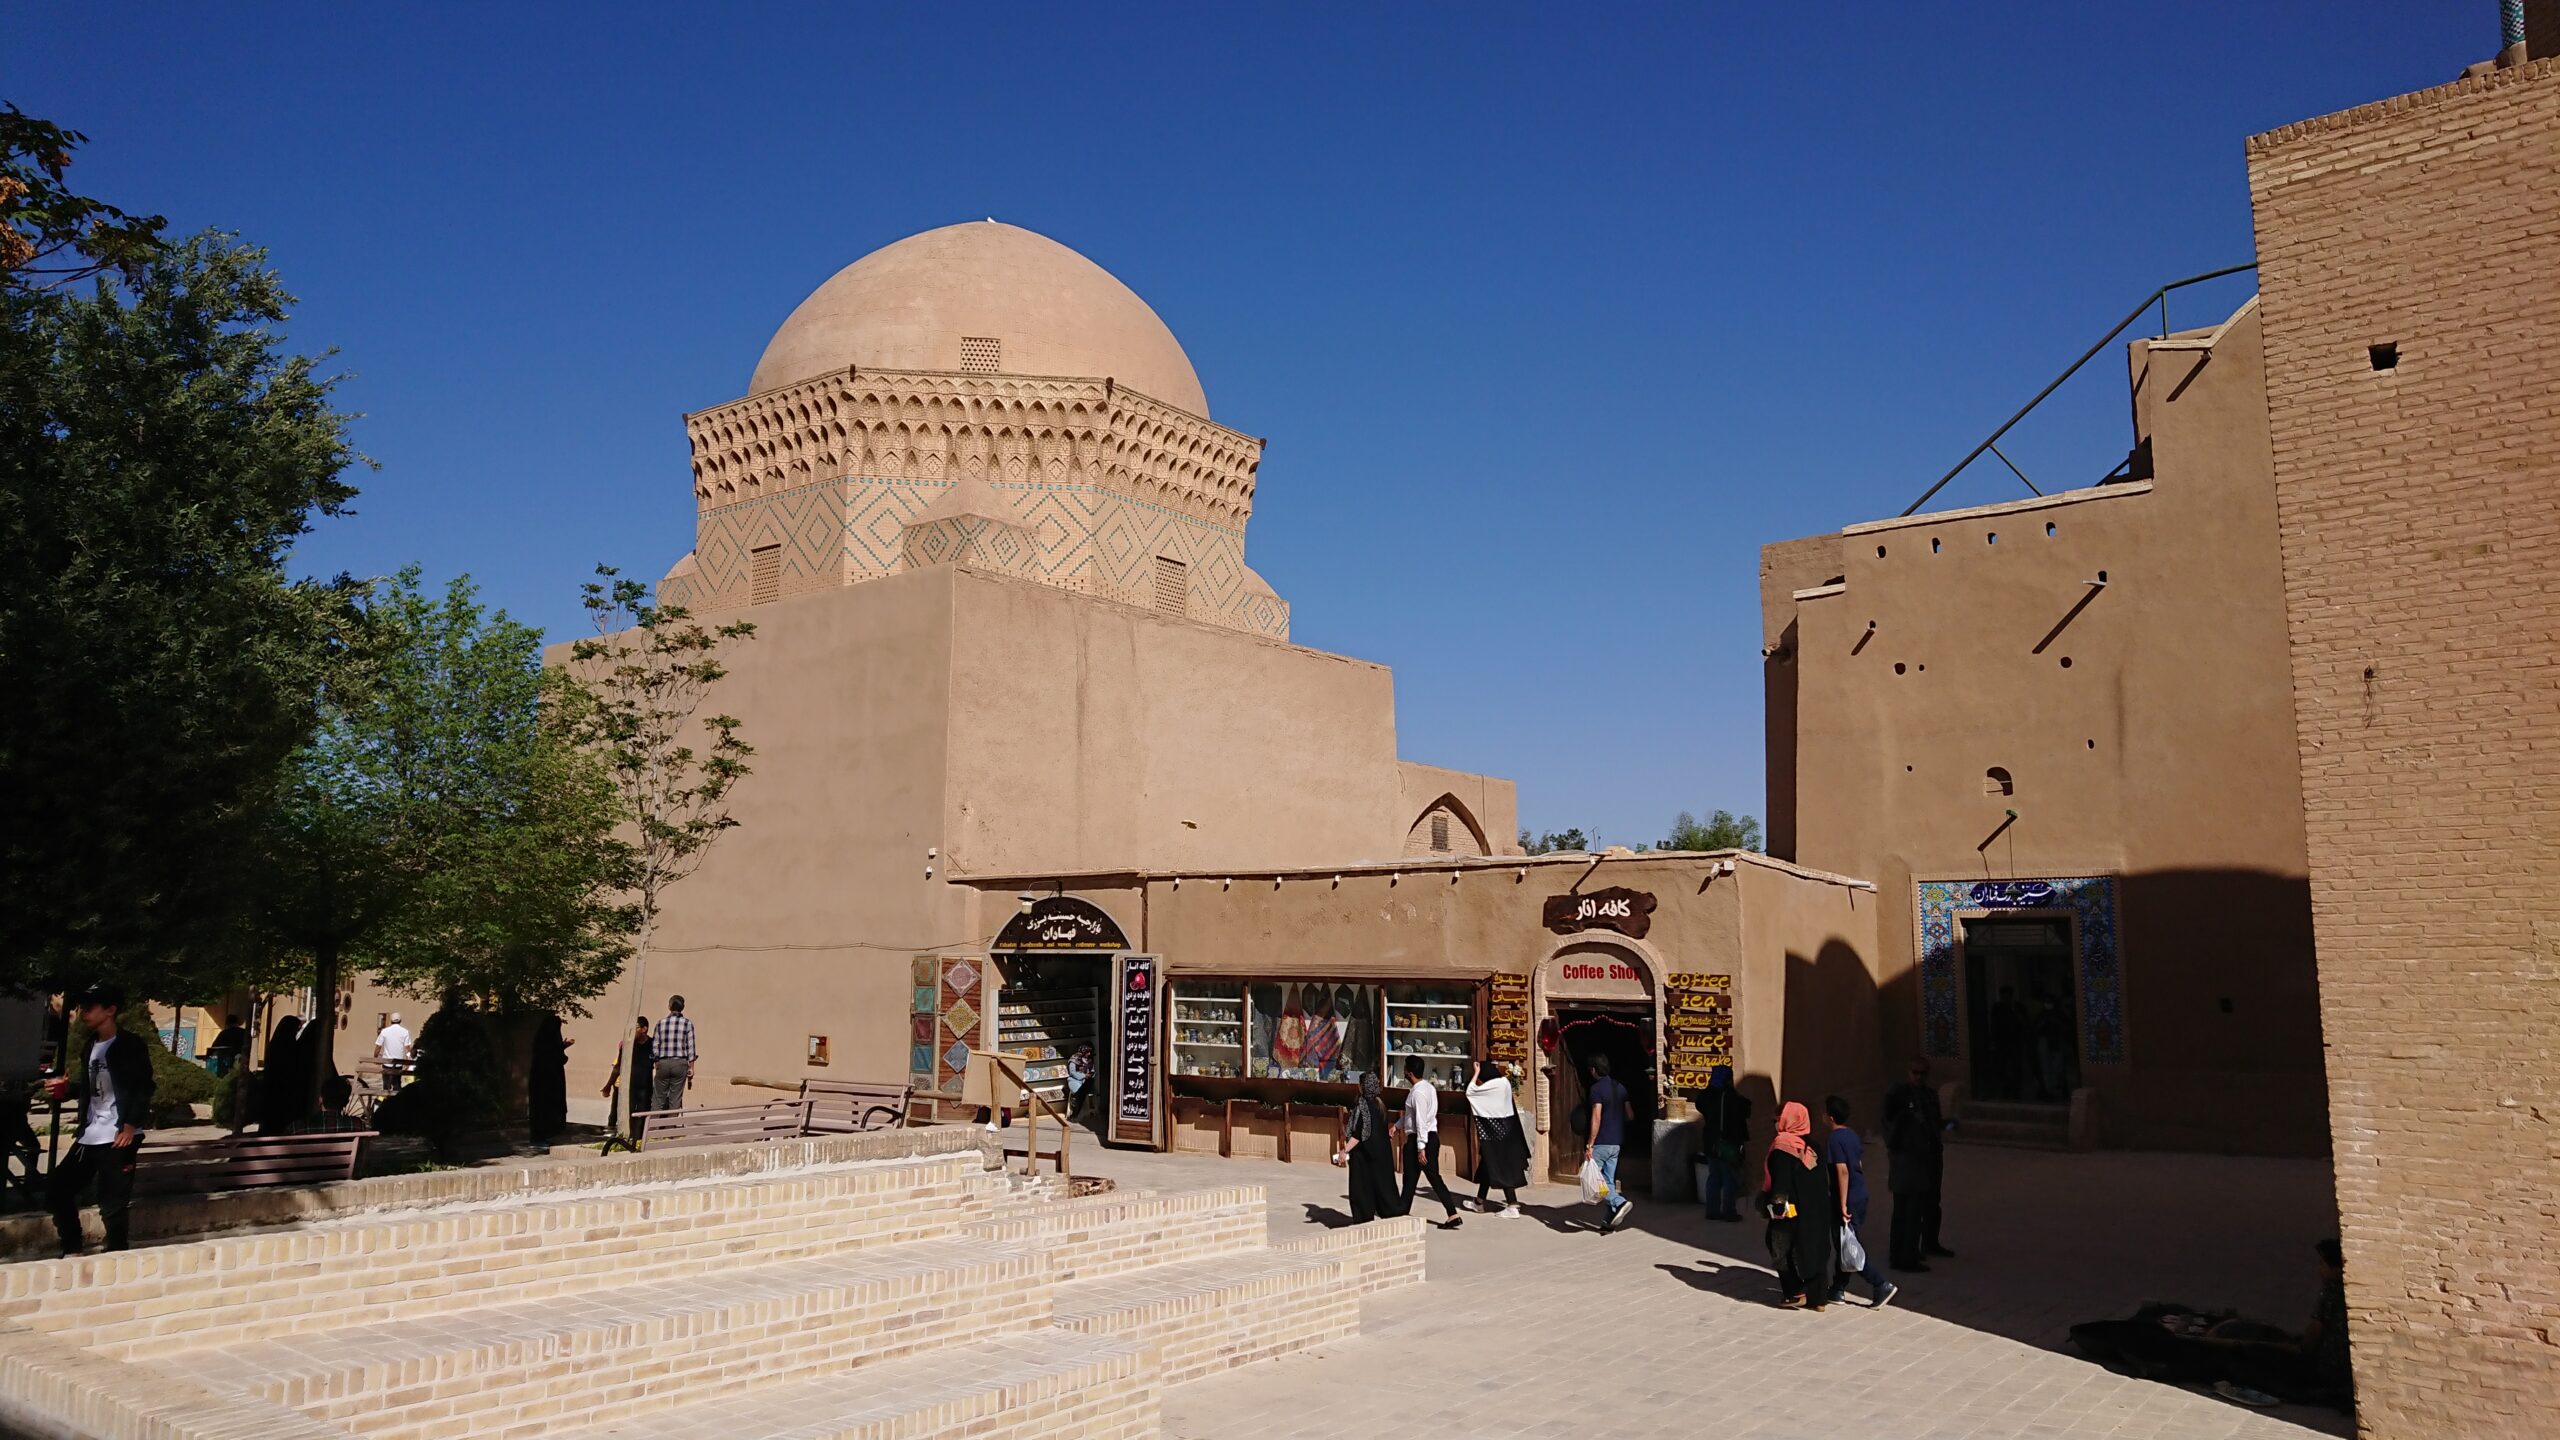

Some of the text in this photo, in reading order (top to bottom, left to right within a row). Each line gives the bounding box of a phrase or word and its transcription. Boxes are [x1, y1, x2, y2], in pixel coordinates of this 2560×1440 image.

[1576, 898, 1631, 921] کافه انار
[1027, 911, 1102, 935] بازارچه حسینیه بزرگ
[1042, 923, 1077, 941] فهادان
[1126, 961, 1150, 972] کافه انار
[1563, 964, 1641, 981] Coffee Shop
[1492, 974, 1526, 985] قهوه
[1681, 994, 1717, 1007] tea
[1677, 1034, 1726, 1047] juice
[1696, 1054, 1733, 1067] shake
